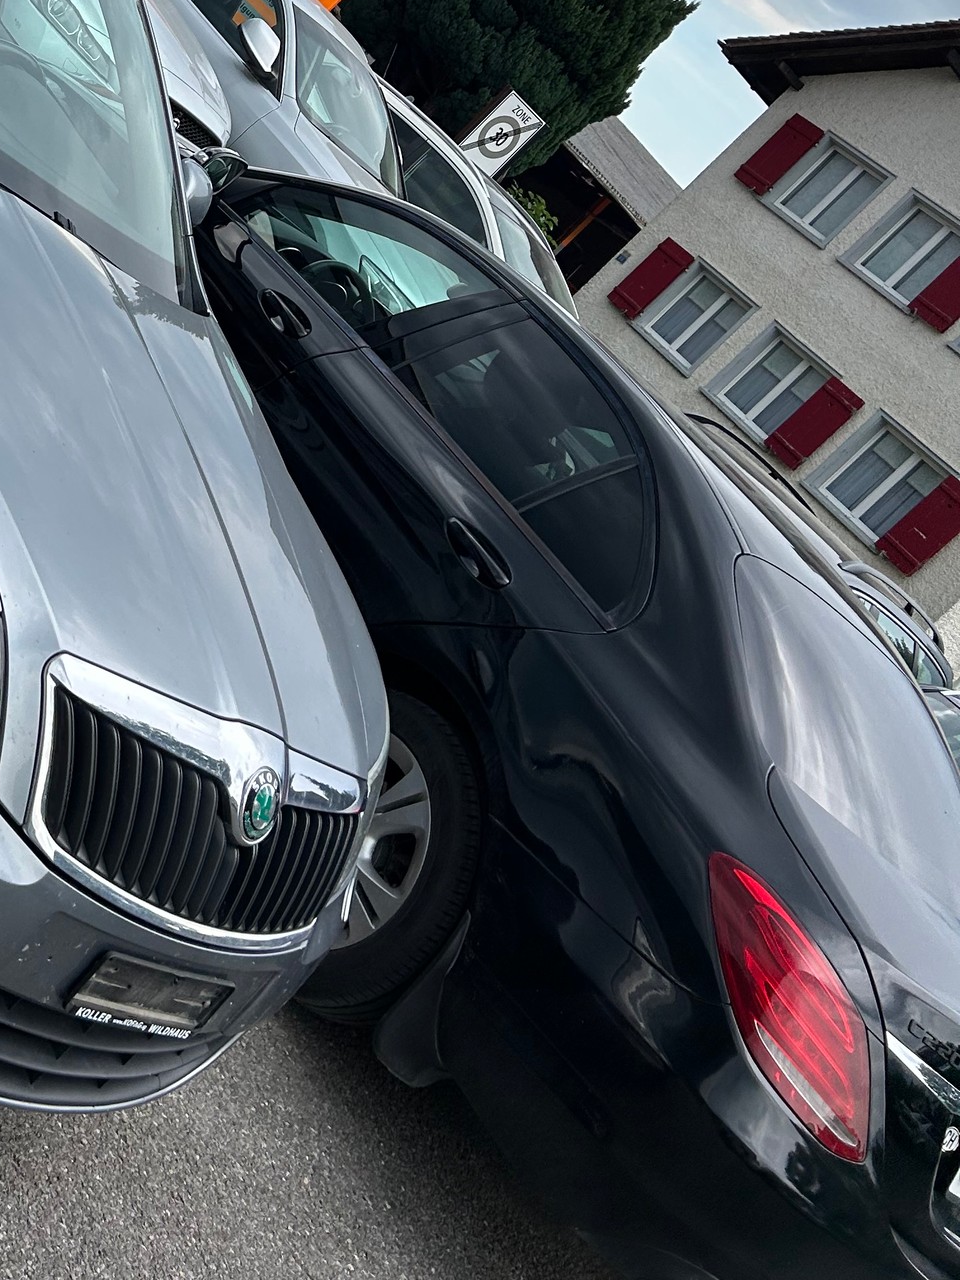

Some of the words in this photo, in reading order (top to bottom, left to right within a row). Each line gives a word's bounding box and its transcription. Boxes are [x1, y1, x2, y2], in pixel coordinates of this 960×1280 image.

[511, 104, 533, 125] ZONE
[490, 127, 509, 147] 30
[75, 1006, 113, 1024] KOLLER
[147, 1023, 192, 1039] WILDHAUS
